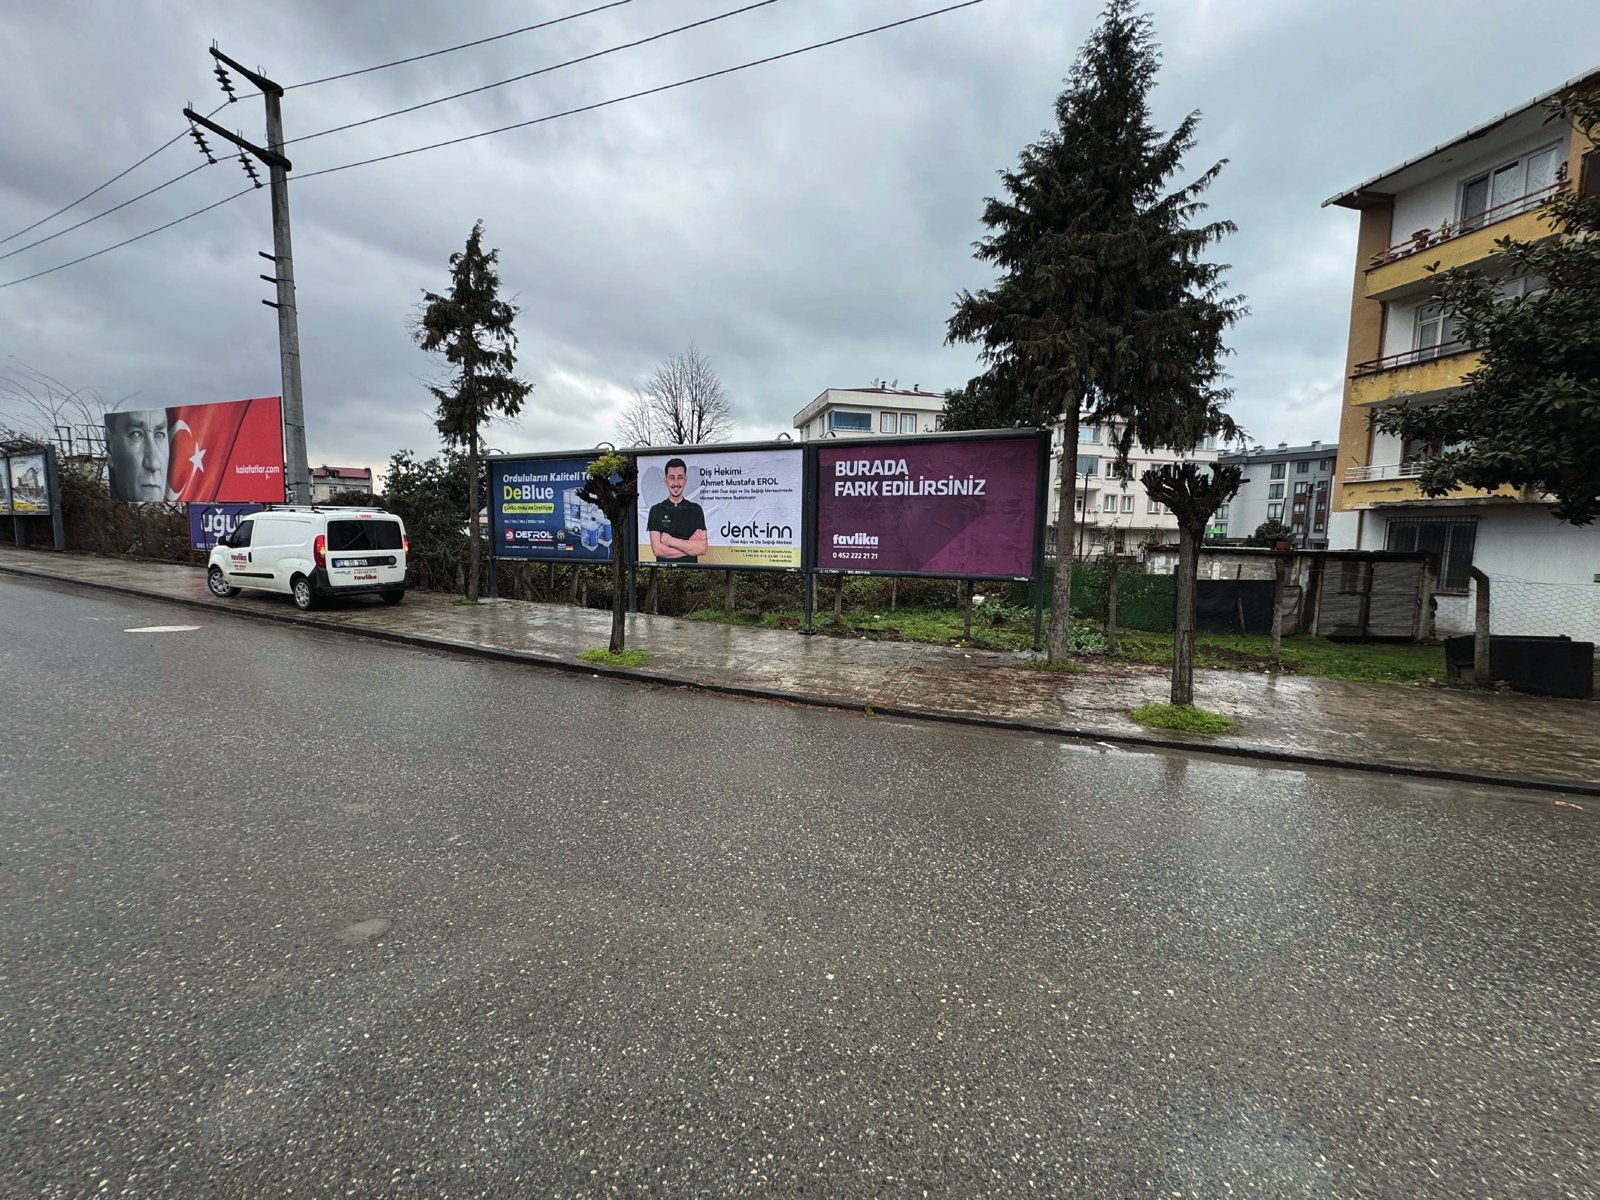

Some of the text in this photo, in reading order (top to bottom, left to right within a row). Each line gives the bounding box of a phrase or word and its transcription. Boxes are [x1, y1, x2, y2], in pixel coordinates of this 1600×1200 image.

[236, 464, 280, 474] kalafatlar.com
[700, 466, 742, 478] Diş Hekimi
[835, 459, 909, 477] BURADA
[503, 474, 548, 483] Orduluların
[550, 471, 580, 482] Kaliteli
[726, 478, 755, 486] Mustafa
[757, 478, 779, 486] EROL
[503, 484, 554, 500] DeBlue
[834, 475, 986, 497] FARK EDİLİRSİNİZ
[201, 508, 248, 537] uğu
[515, 530, 553, 539] DEFROL
[720, 520, 792, 539] dent-inn
[832, 532, 879, 545] favlika
